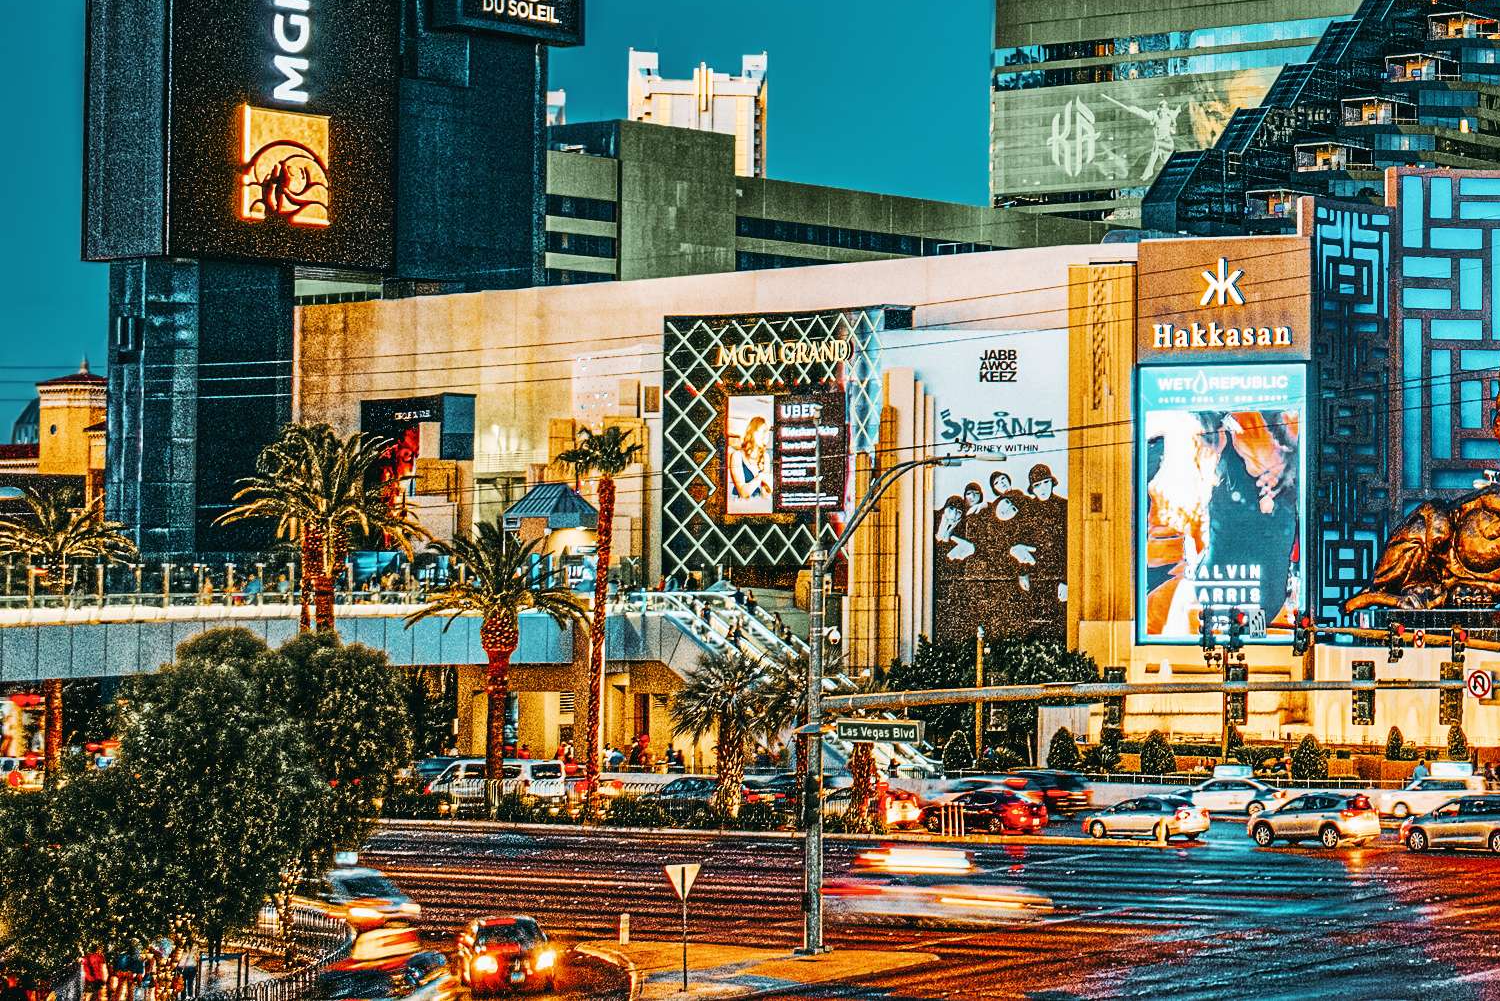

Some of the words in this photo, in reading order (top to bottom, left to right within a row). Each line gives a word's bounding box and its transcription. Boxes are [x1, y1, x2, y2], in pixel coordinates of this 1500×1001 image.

[1152, 323, 1292, 349] Hakkasan
[714, 343, 776, 367] MGM
[781, 339, 849, 364] GRAND
[979, 350, 1017, 360] JABB
[979, 361, 1017, 370] AWOC
[979, 371, 1017, 382] KEEZ
[1158, 377, 1193, 391] WET
[1209, 375, 1289, 389] REPUBLIC
[1005, 444, 1039, 452] WITHIN
[1199, 587, 1261, 602] ARRIS
[840, 726, 858, 737] Las
[861, 727, 889, 740] Vegas
[893, 727, 915, 739] Blvd
